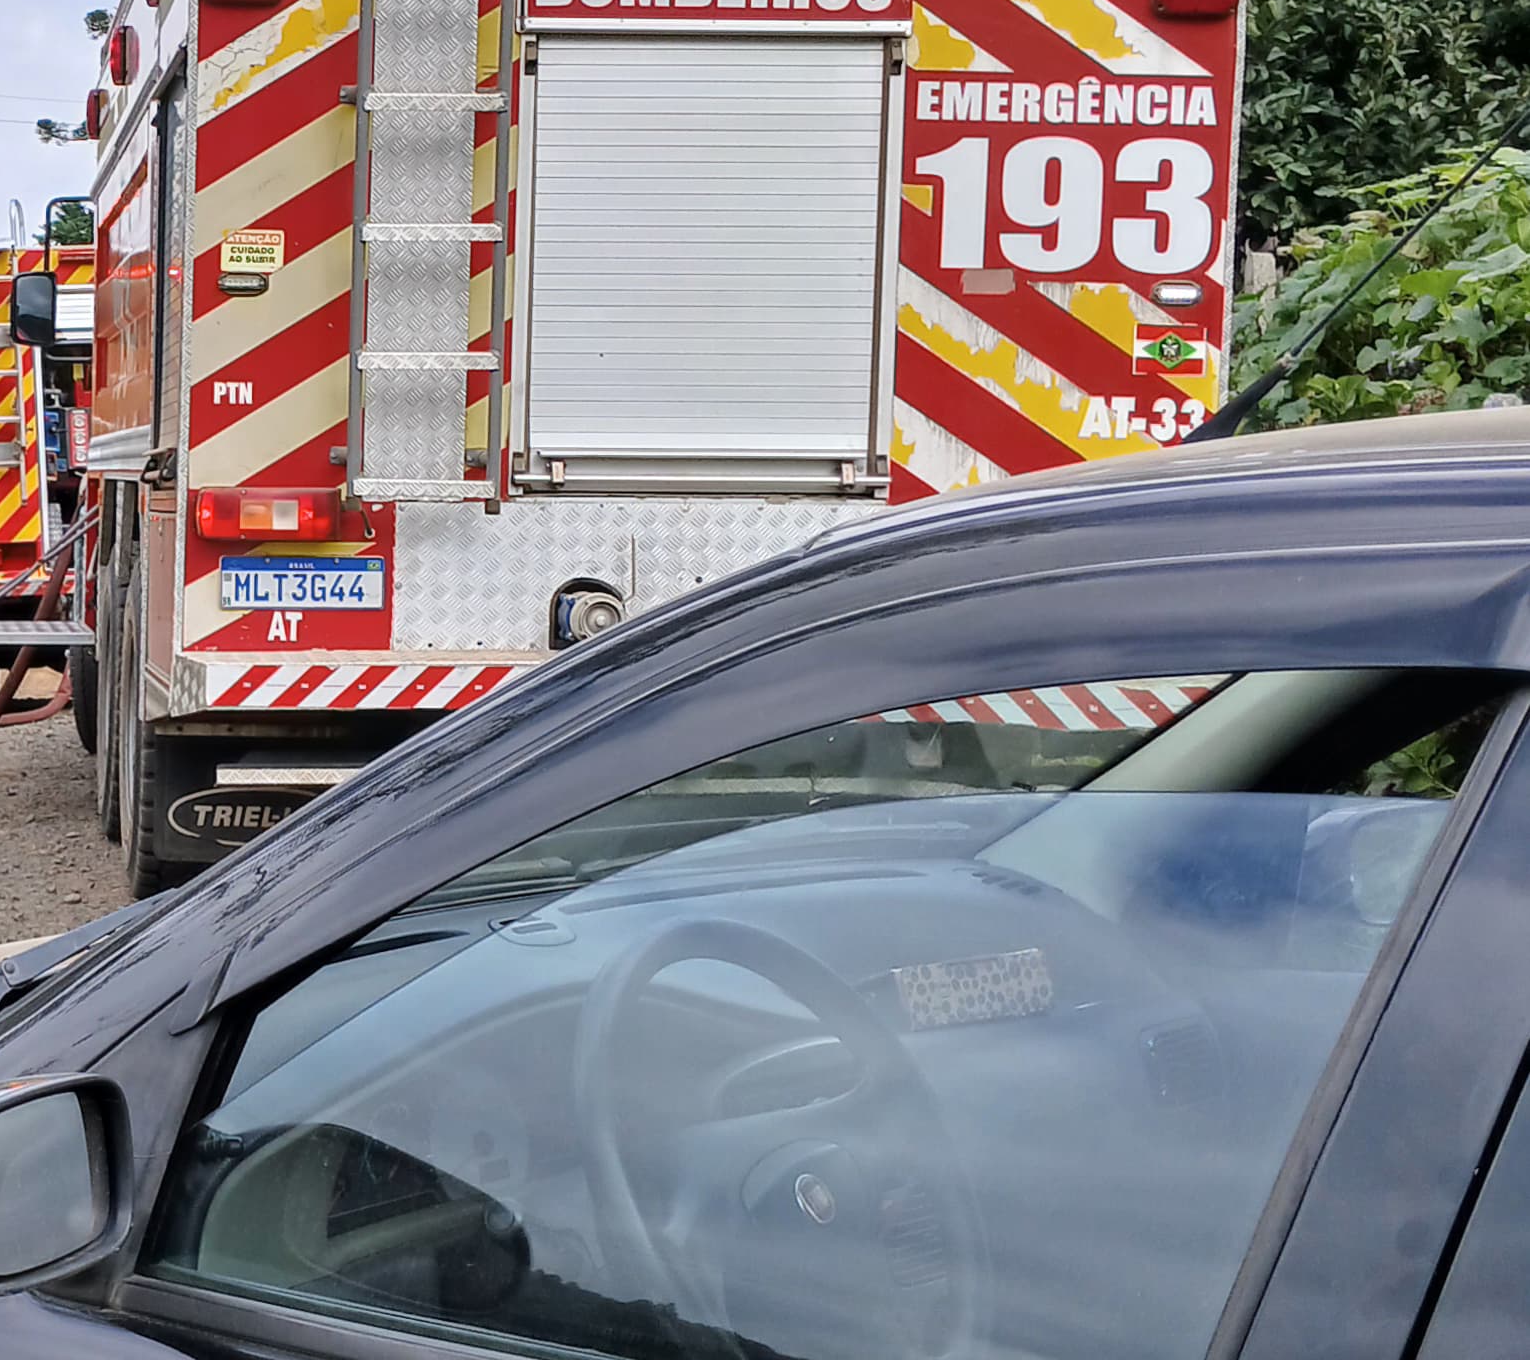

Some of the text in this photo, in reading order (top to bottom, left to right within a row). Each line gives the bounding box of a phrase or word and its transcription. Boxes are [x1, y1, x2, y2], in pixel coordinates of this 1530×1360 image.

[916, 76, 1218, 126] EMERGÊNCIA
[915, 135, 1215, 275] 193
[228, 255, 243, 263] AO
[230, 246, 275, 254] CUIDADO
[213, 381, 253, 405] PTN
[1078, 396, 1206, 442] AT-33
[288, 562, 316, 570] BRASIL
[234, 573, 366, 603] MLT3G44
[267, 611, 303, 642] AT
[193, 805, 291, 827] TRIEL-
